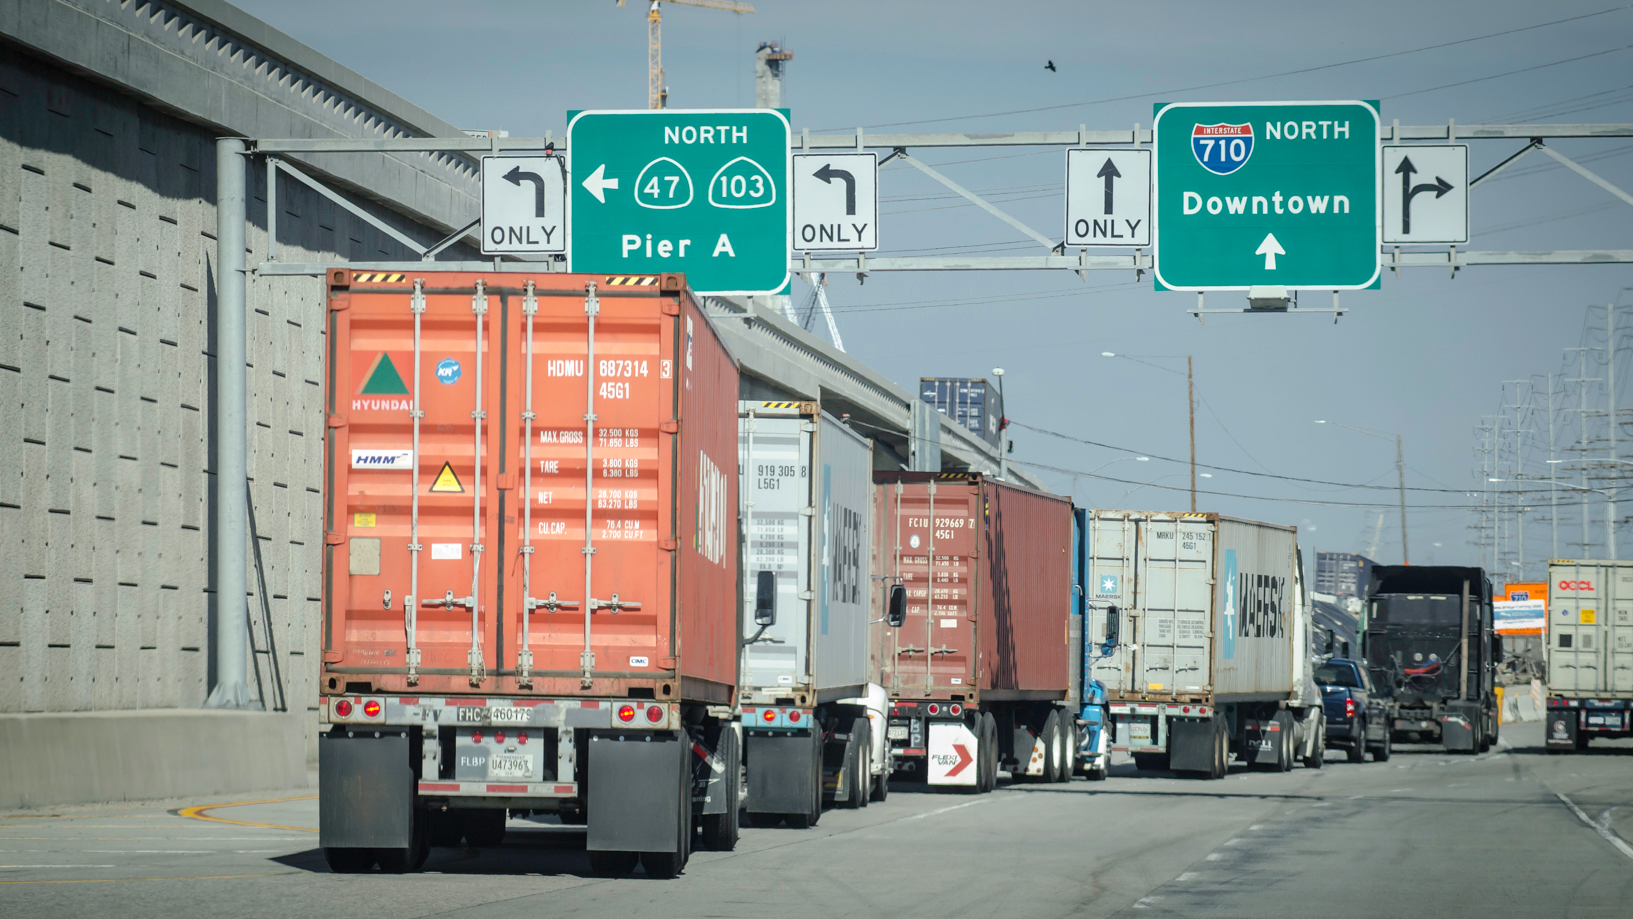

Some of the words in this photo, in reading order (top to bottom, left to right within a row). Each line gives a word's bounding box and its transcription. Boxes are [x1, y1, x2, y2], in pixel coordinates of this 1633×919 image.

[664, 126, 748, 144] NORTH
[1203, 127, 1242, 135] INTERSTATE
[1266, 121, 1349, 140] NORTH
[1199, 139, 1246, 162] 710
[644, 177, 679, 198] 47
[720, 175, 765, 197] 103
[1183, 191, 1349, 215] Downtown
[491, 226, 556, 245] ONLY
[802, 224, 867, 243] ONLY
[1075, 219, 1142, 238] ONLY
[622, 234, 690, 258] Pier
[712, 233, 735, 257] A
[548, 360, 584, 377] HDMU
[599, 360, 648, 377] 687314
[662, 361, 670, 377] 3
[599, 382, 630, 399] 45G1
[352, 399, 413, 411] HYUNDAI
[599, 429, 622, 437] 32.500
[625, 429, 639, 438] KGS
[599, 438, 623, 447] 71.650
[625, 438, 639, 447] LBS
[356, 456, 396, 464] HMM
[540, 461, 559, 474] TARE
[625, 459, 638, 468] KGS
[625, 469, 638, 477] LBS
[758, 465, 775, 476] 919
[778, 466, 795, 477] 305
[801, 467, 807, 477] 8
[758, 478, 780, 489] L5G1
[538, 492, 553, 504] NET
[625, 490, 638, 499] KGS
[625, 500, 638, 509] LBS
[909, 518, 928, 527] FCIU
[935, 518, 964, 527] 929669
[935, 530, 954, 539] 45G1
[1157, 531, 1174, 539] MRKU
[1182, 532, 1193, 540] 245
[1239, 573, 1285, 638] MAERSK
[461, 756, 486, 767] FLBP
